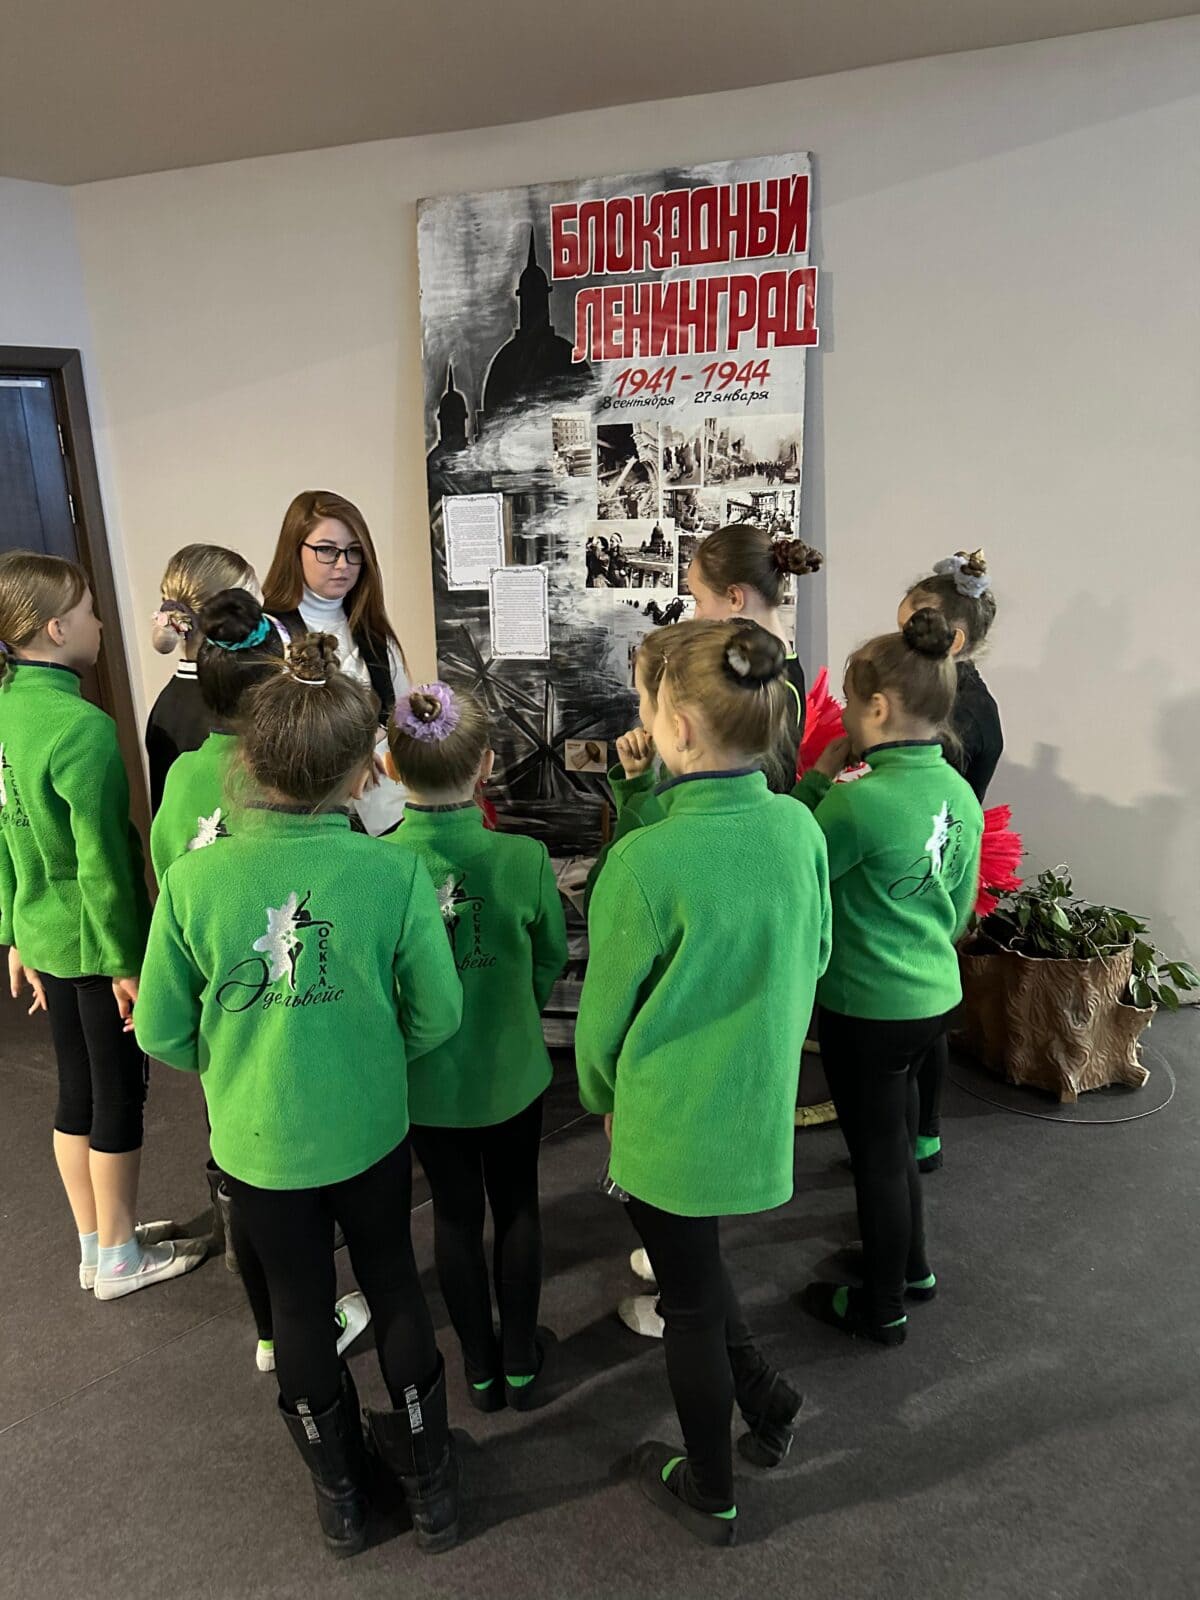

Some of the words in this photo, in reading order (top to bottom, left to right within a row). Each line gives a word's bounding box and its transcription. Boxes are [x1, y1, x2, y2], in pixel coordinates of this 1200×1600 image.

[550, 174, 809, 281] БЛОКАДНЫЙ
[571, 267, 819, 364] ЛЕНИНГРАД
[612, 366, 677, 398] 1941
[701, 359, 771, 391] 1944
[613, 396, 675, 410] сентября
[694, 391, 711, 404] 27
[711, 388, 770, 406] января
[215, 957, 345, 1013] Эдельвейс
[318, 927, 330, 988] ОСКХА
